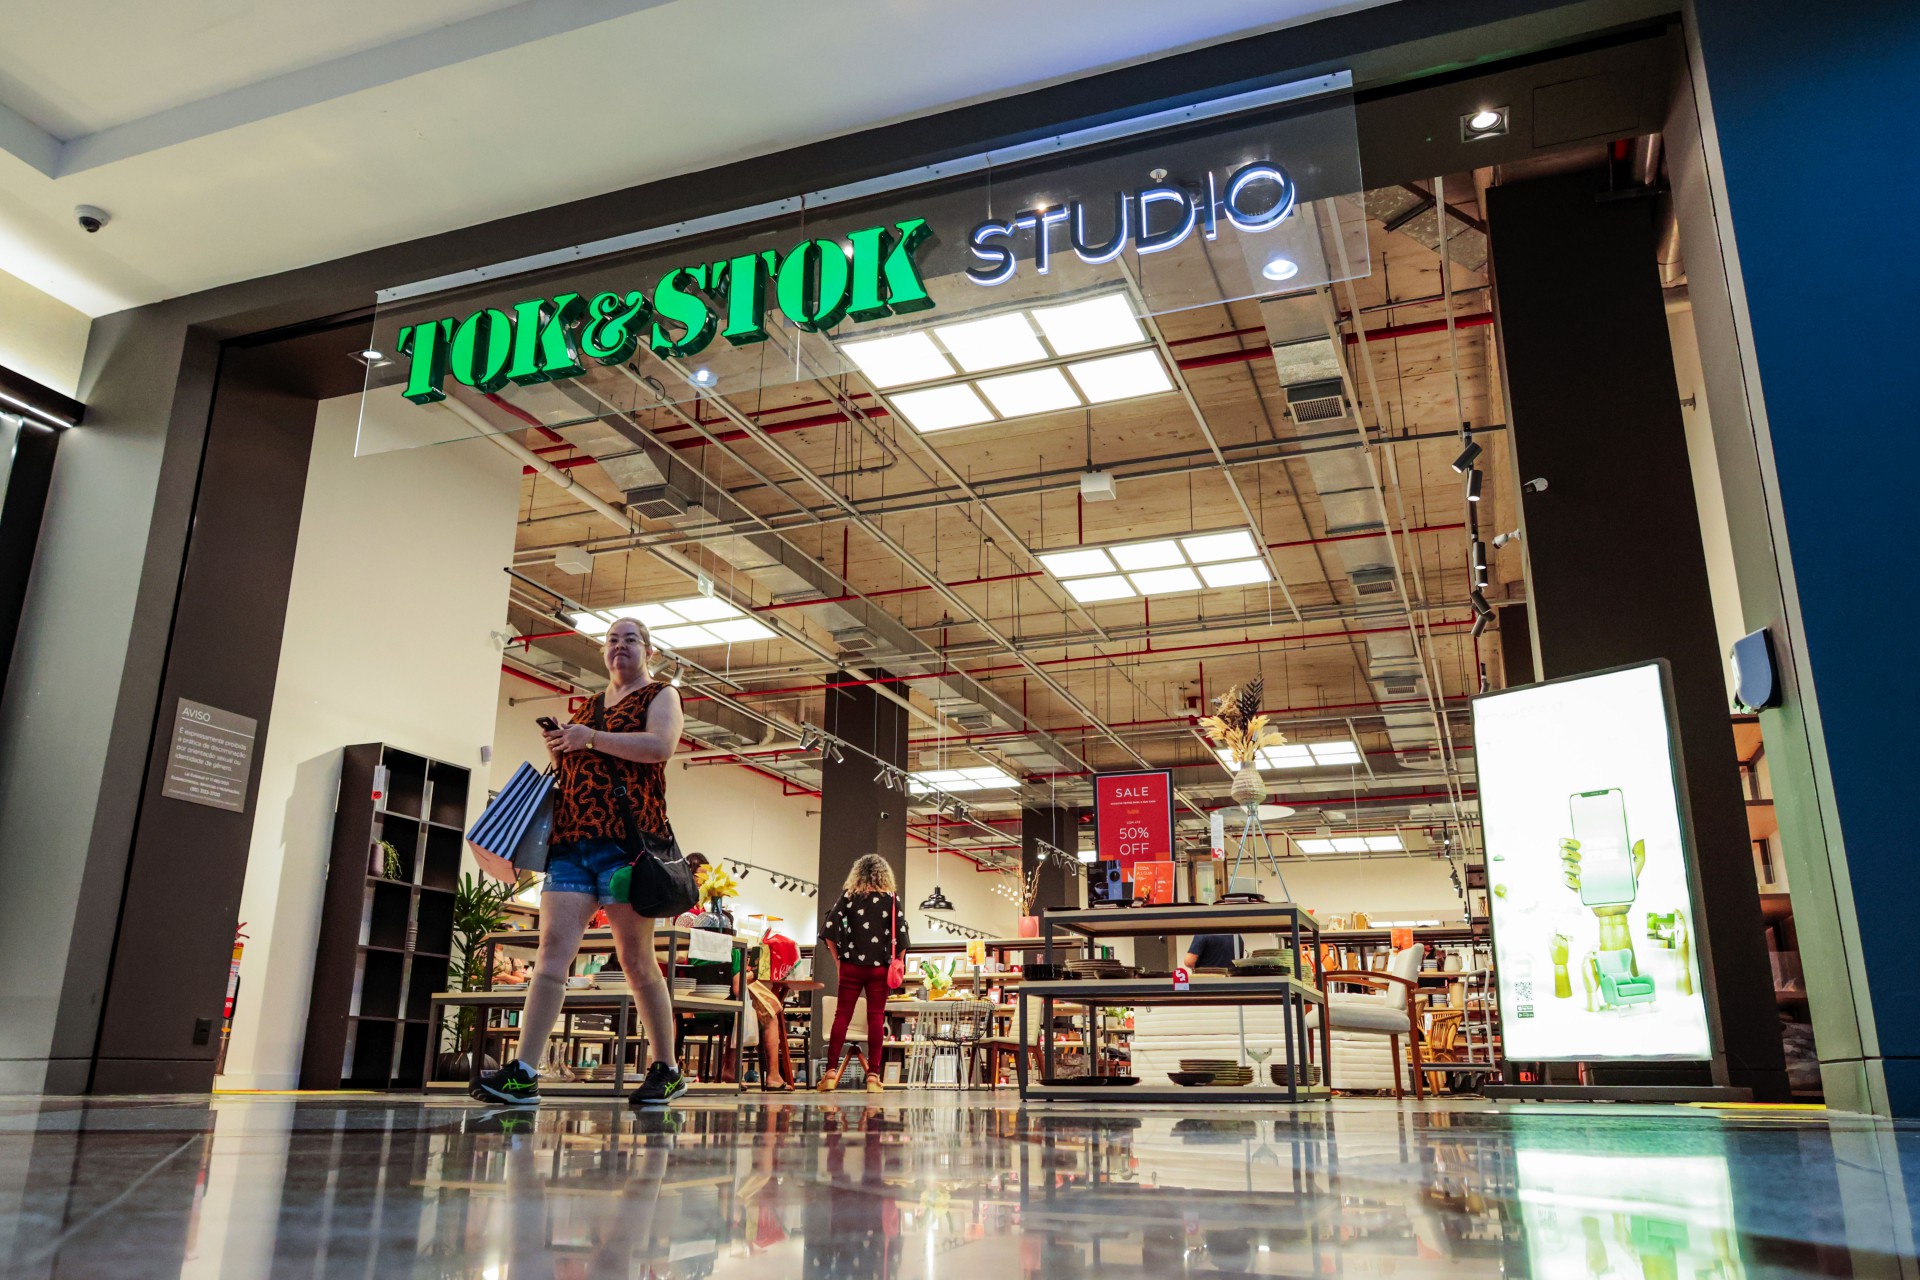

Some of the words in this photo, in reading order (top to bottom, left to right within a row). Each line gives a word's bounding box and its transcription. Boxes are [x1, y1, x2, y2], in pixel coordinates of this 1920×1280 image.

[396, 217, 934, 403] TOK&STOK
[965, 160, 1295, 286] STUDIO
[182, 707, 211, 722] AVISO
[184, 730, 225, 745] expressamente
[225, 741, 247, 751] proibida
[182, 738, 202, 747] prática
[210, 745, 246, 759] discriminação
[187, 747, 216, 759] orientação
[216, 755, 234, 764] sexual
[175, 753, 204, 765] identidade
[1115, 786, 1149, 798] SALE
[1119, 826, 1149, 840] 50%
[1119, 842, 1150, 856] OFF
